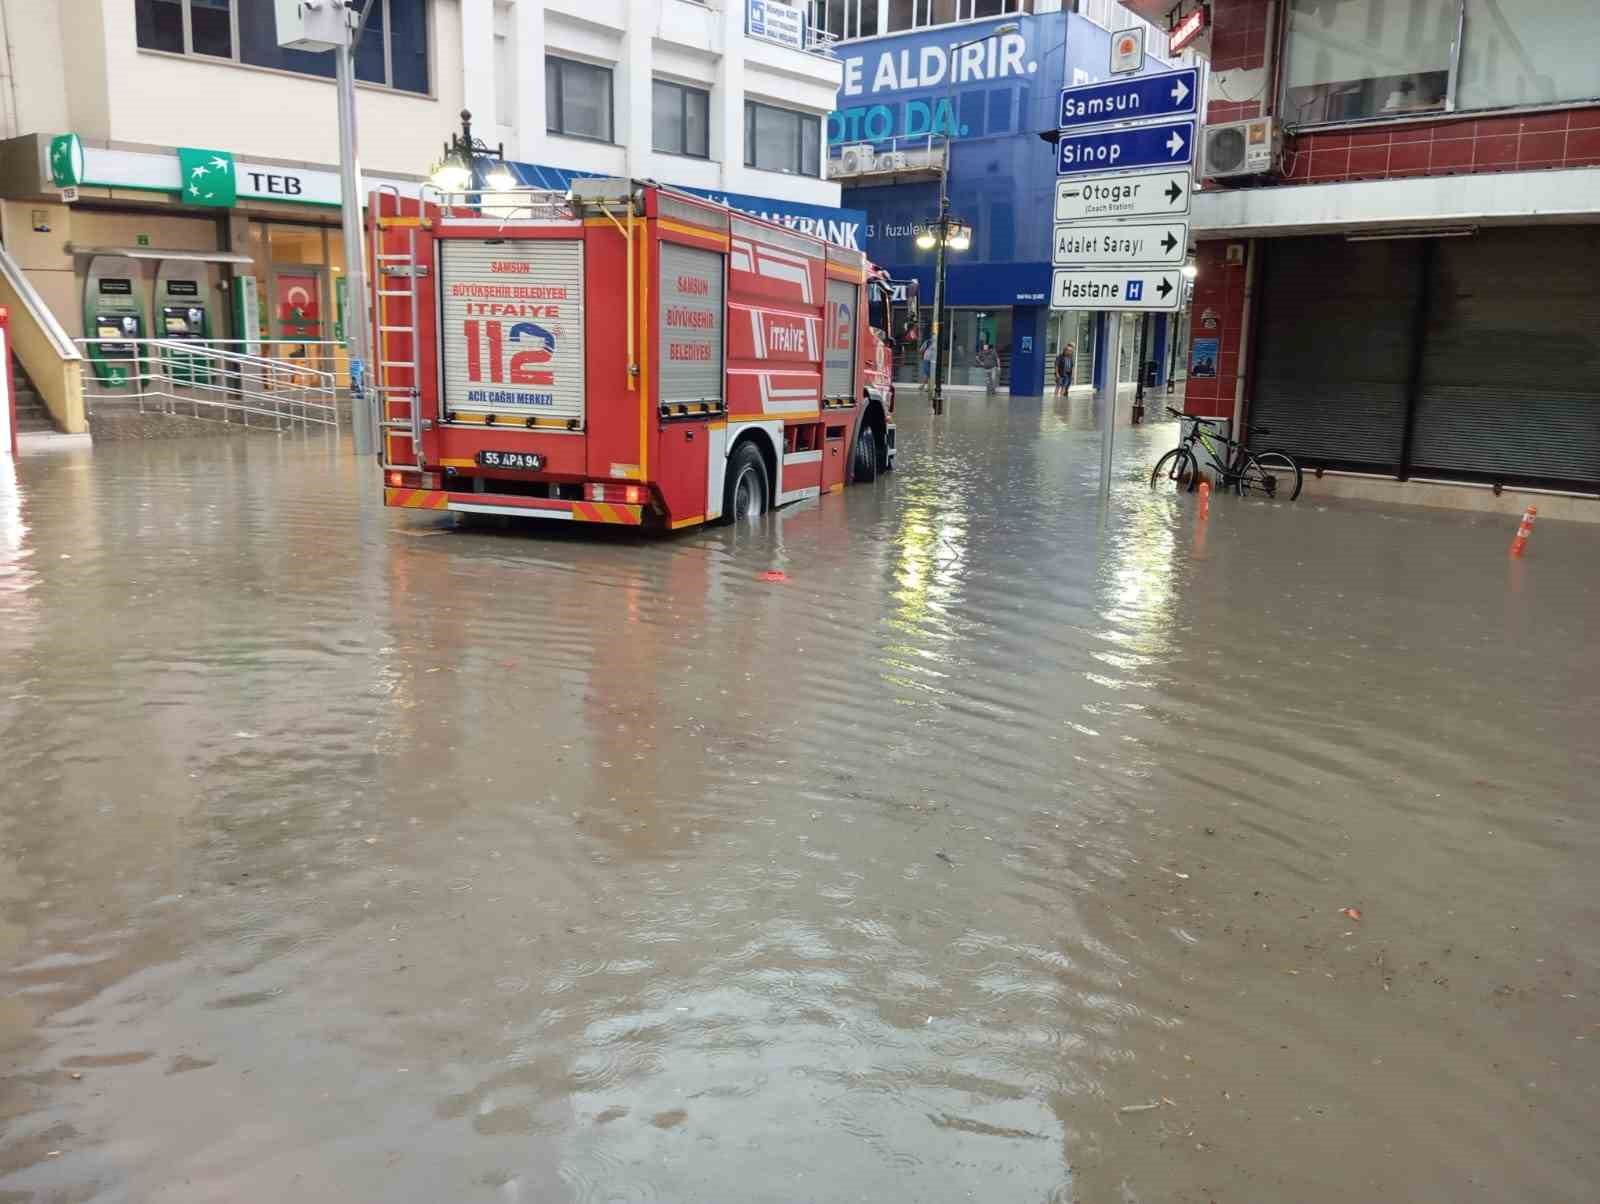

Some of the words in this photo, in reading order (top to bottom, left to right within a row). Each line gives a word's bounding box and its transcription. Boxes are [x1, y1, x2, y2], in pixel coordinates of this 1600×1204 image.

[871, 33, 1038, 93] ALDIRIR.
[1065, 93, 1140, 117] Samsun
[905, 98, 969, 141] DA.
[1063, 143, 1121, 164] Sinop
[248, 172, 302, 196] TEB
[1082, 183, 1141, 202] Otogar
[1085, 204, 1107, 214] (Coach
[1108, 203, 1134, 212] Station)
[738, 207, 859, 251] KBANK
[1058, 236, 1097, 253] Adalet
[1104, 235, 1144, 256] Sarayı
[490, 260, 530, 273] SAMSUN
[453, 282, 514, 298] BÜYÜKŞEHİR
[515, 284, 567, 301] BELEDİYESİ
[677, 275, 708, 297] SAMSUN
[1062, 279, 1119, 299] Hastane
[466, 300, 560, 318] İTFAİYE
[667, 304, 714, 330] BÜYÜKŞEHİR
[769, 319, 805, 353] İTFAİYE
[826, 300, 852, 351] 112
[463, 319, 556, 386] 112
[670, 341, 712, 361] BELEDİYESİ
[468, 390, 488, 403] ACİL
[489, 389, 515, 404] ÇAĞRI
[517, 392, 553, 406] MERKEZİ
[485, 451, 500, 465] 55
[502, 453, 524, 467] APA
[526, 455, 539, 468] 94
